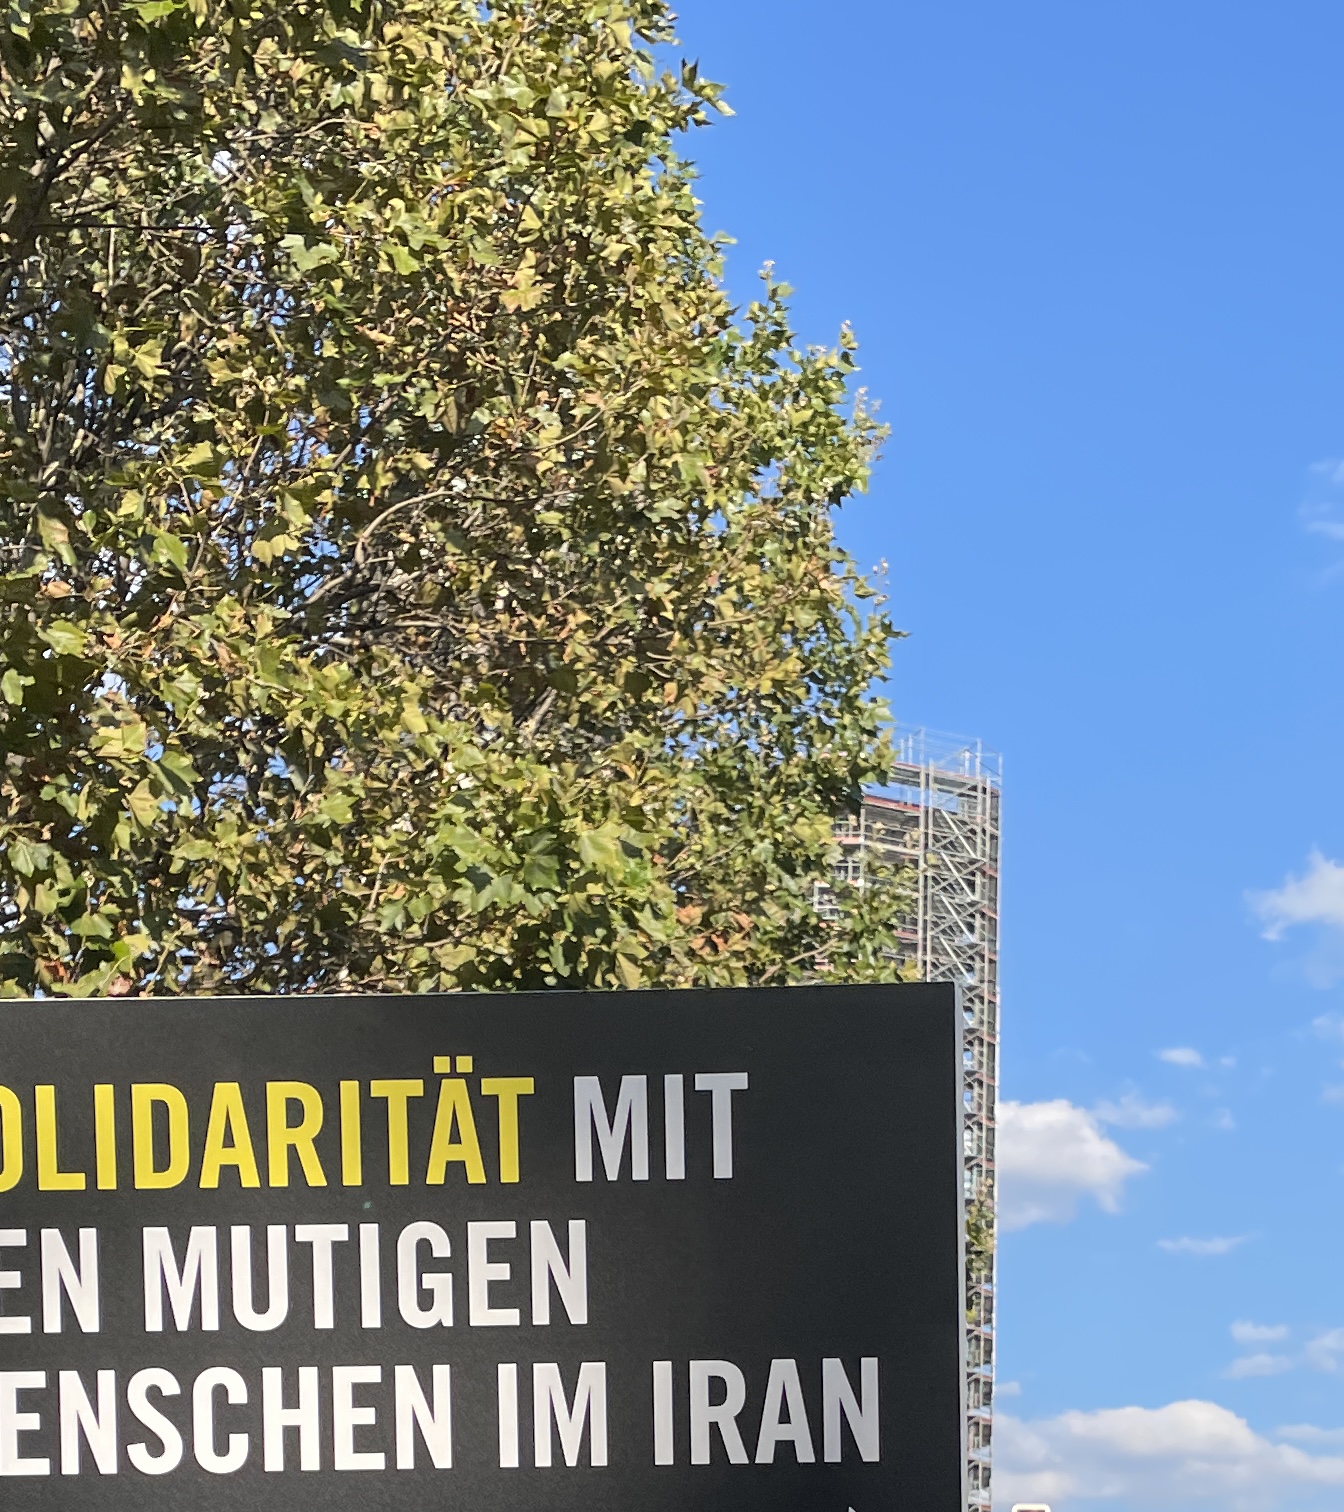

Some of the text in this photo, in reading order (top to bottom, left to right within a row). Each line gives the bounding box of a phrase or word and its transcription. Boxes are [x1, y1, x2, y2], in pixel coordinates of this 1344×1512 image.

[574, 1072, 749, 1182] MIT
[143, 1220, 588, 1332] MUTIGEN
[498, 1361, 608, 1468] IM
[653, 1356, 880, 1466] IRAN
